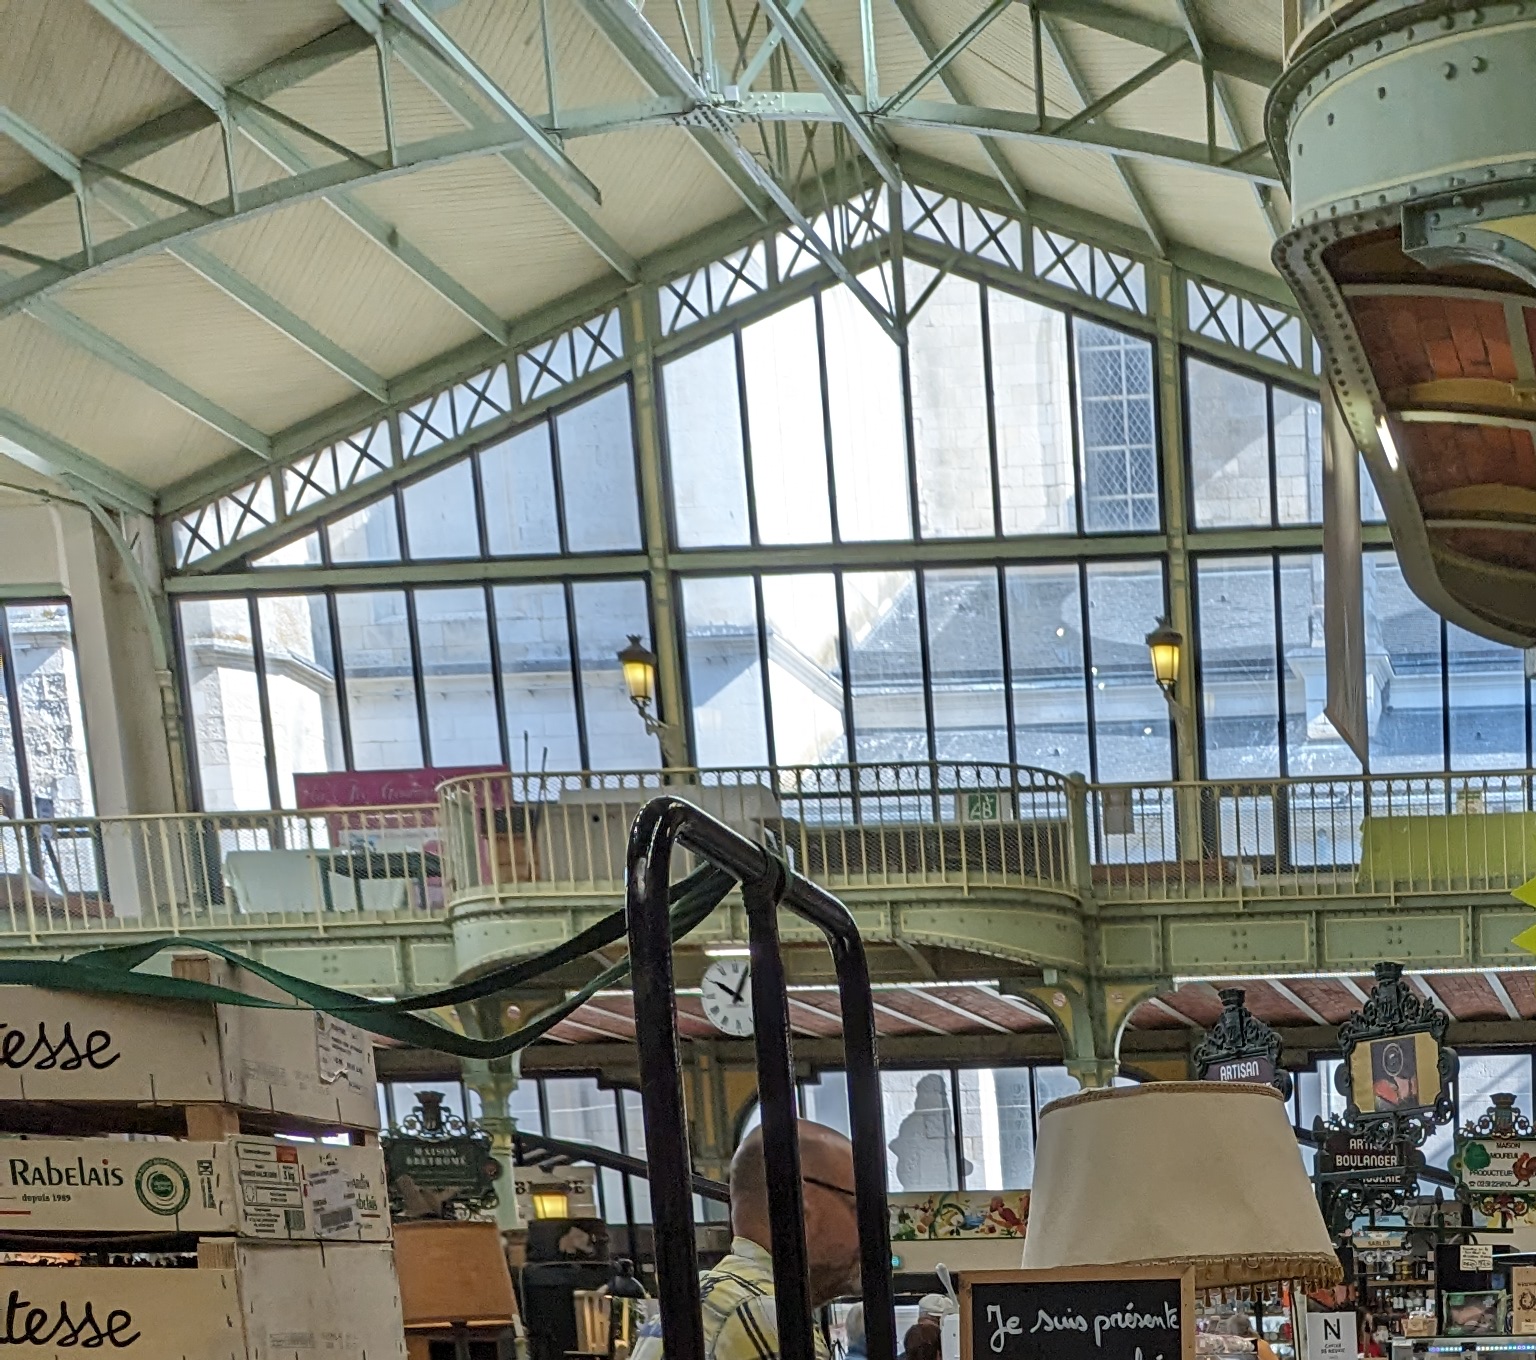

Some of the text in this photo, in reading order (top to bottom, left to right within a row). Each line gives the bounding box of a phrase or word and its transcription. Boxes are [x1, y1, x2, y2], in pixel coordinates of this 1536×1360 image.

[0, 1021, 121, 1070] esse
[1220, 1061, 1260, 1081] ARTISAN
[1335, 1154, 1398, 1167] BOULANGER
[0, 1290, 141, 1348] tesse
[986, 1301, 1180, 1353] Je suis présente
[1323, 1318, 1341, 1341] N
